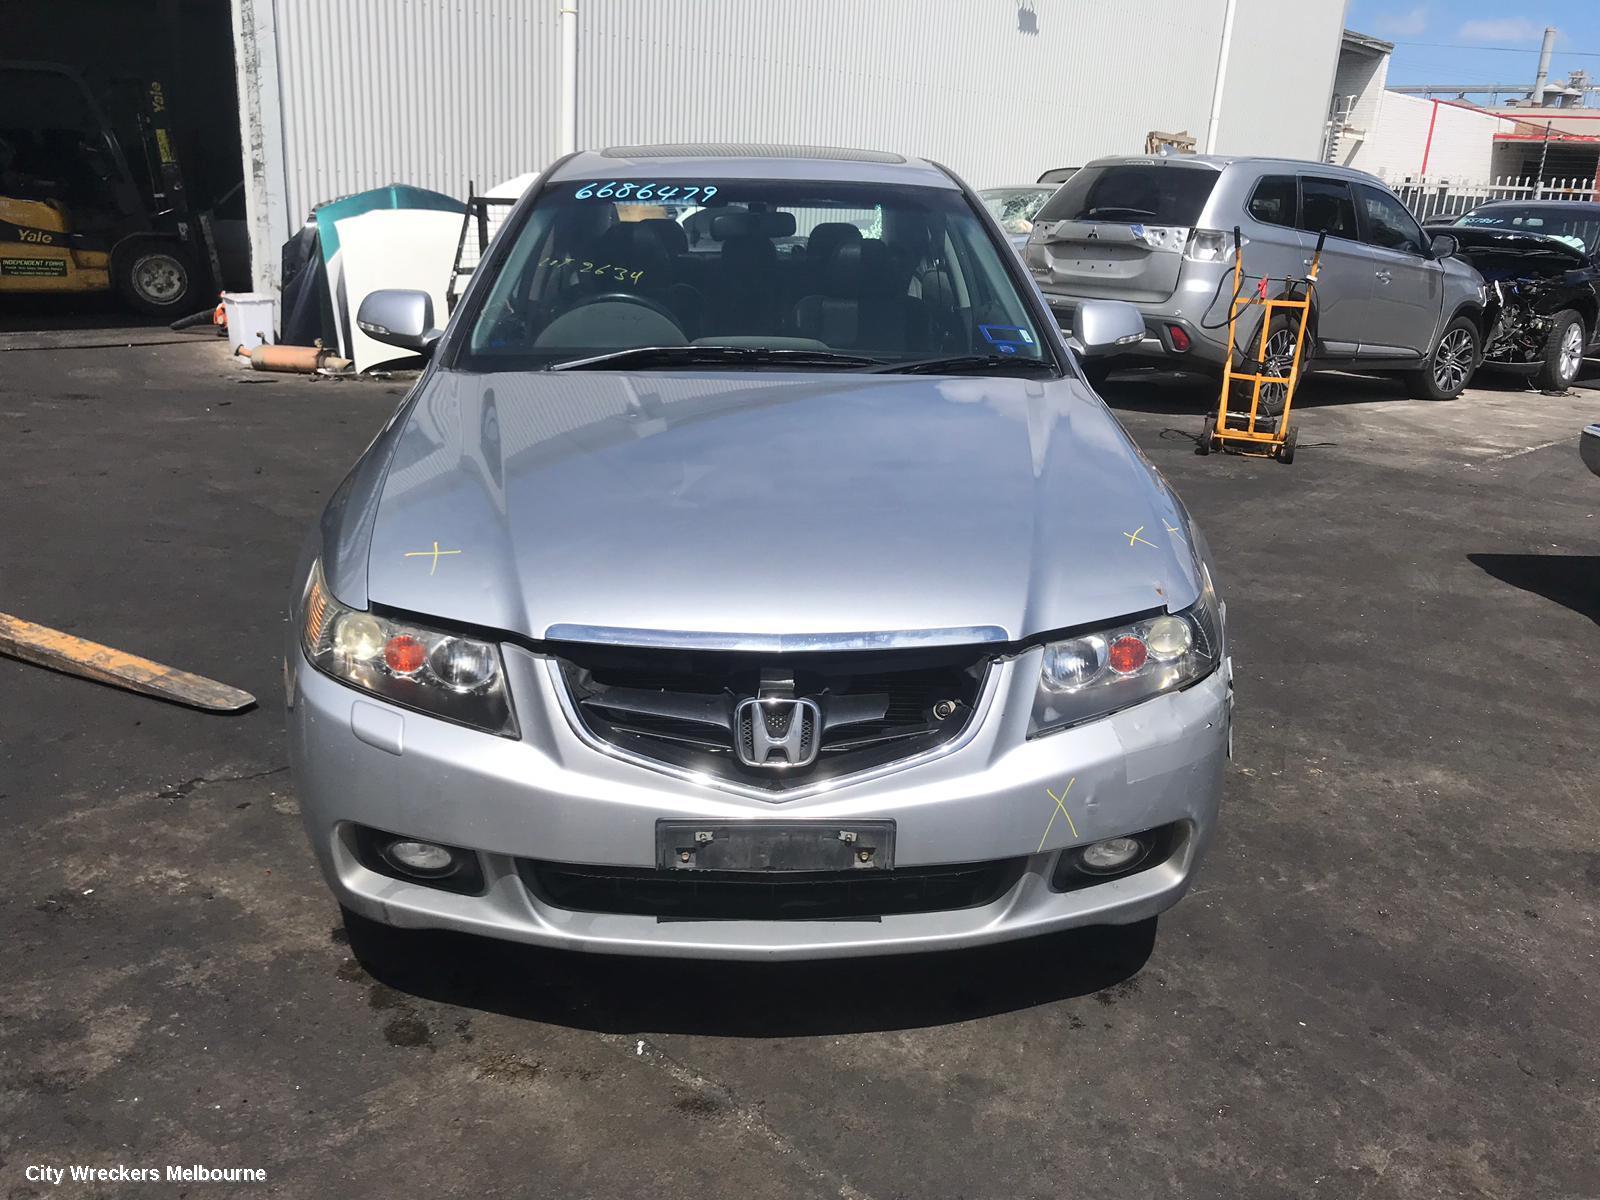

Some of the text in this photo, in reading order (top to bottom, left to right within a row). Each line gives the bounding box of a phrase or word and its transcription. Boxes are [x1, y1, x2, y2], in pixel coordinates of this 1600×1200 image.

[150, 81, 165, 112] Yale
[575, 181, 717, 202] 6686479
[18, 229, 53, 244] Yale
[580, 262, 644, 285] 2634
